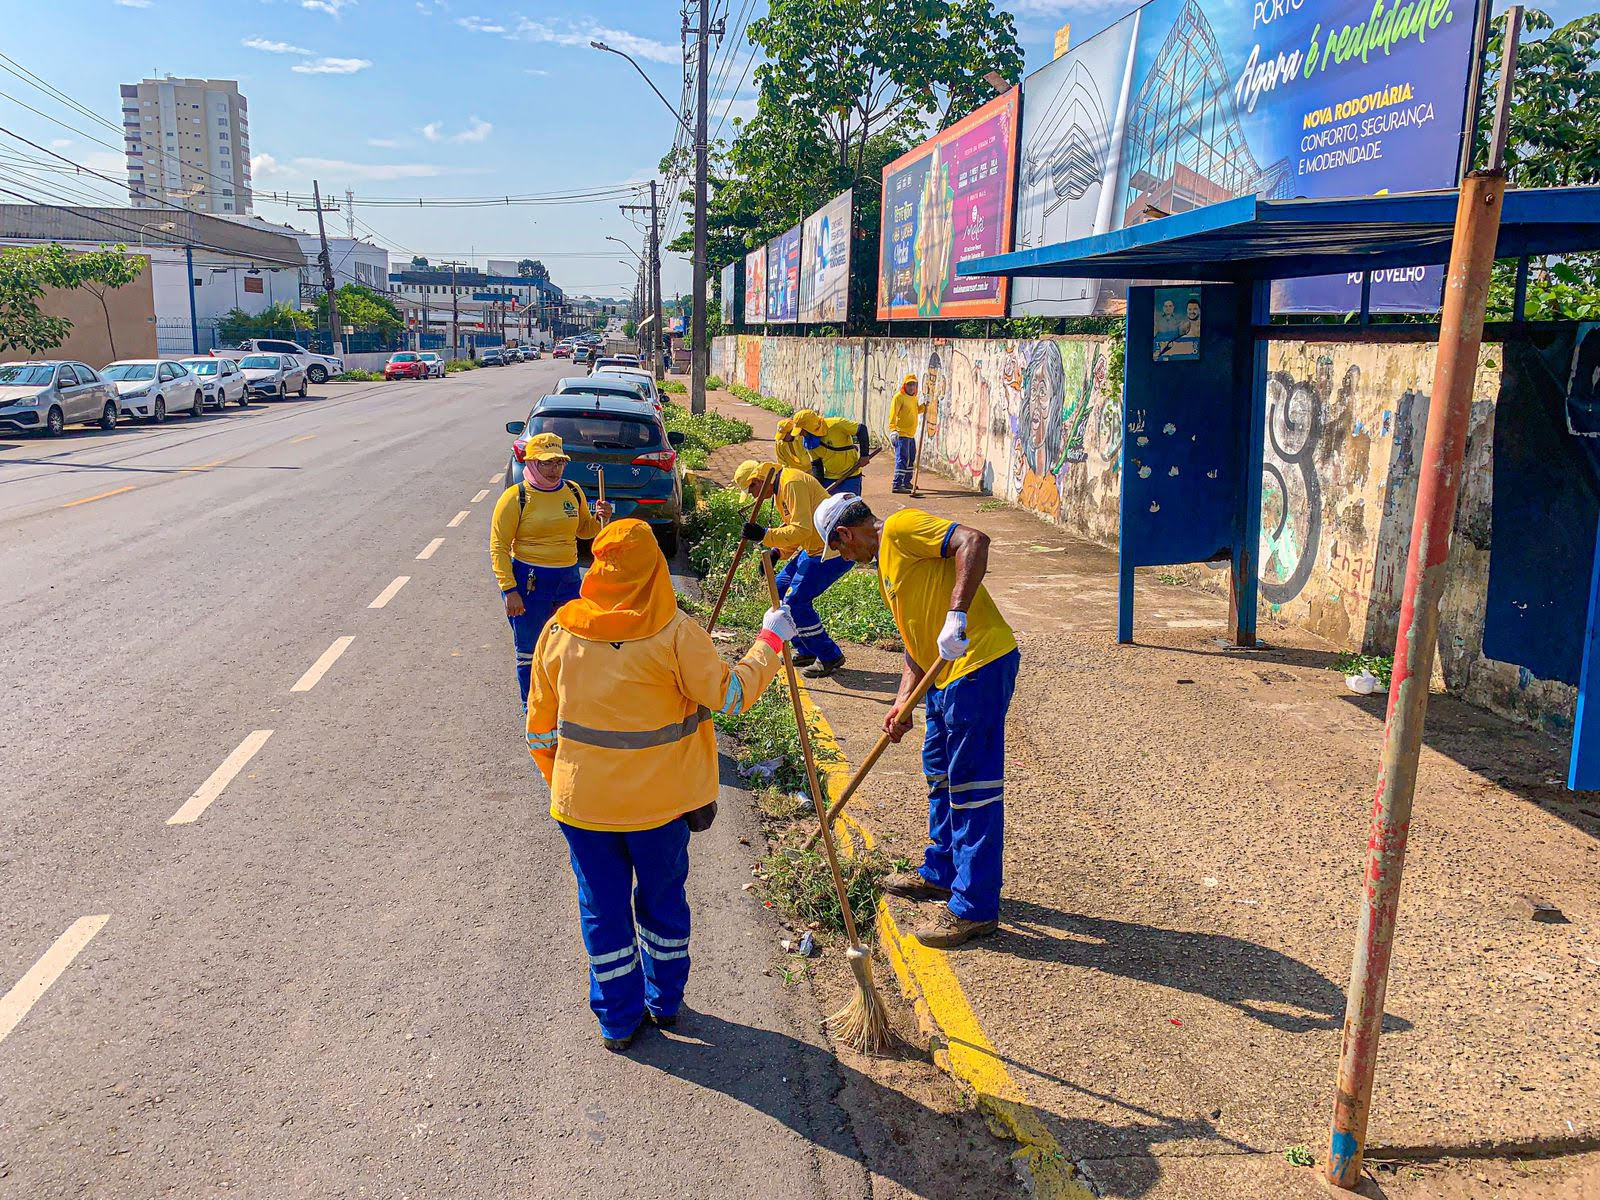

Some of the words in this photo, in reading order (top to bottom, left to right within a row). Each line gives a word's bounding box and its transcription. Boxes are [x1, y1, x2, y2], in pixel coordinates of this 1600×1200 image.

[1235, 44, 1303, 112] Agora
[1304, 23, 1321, 78] é
[1321, 0, 1453, 71] realidade.
[1301, 124, 1358, 152] CONFORTO,
[1360, 102, 1434, 137] SEGURANÇA
[1303, 110, 1332, 130] NOVA
[1335, 82, 1415, 121] RODOVIÁRIA:
[1298, 159, 1306, 175] E
[1306, 141, 1383, 173] MODERNIDADE.
[1347, 270, 1384, 285] POTO
[1385, 266, 1425, 282] VELHO
